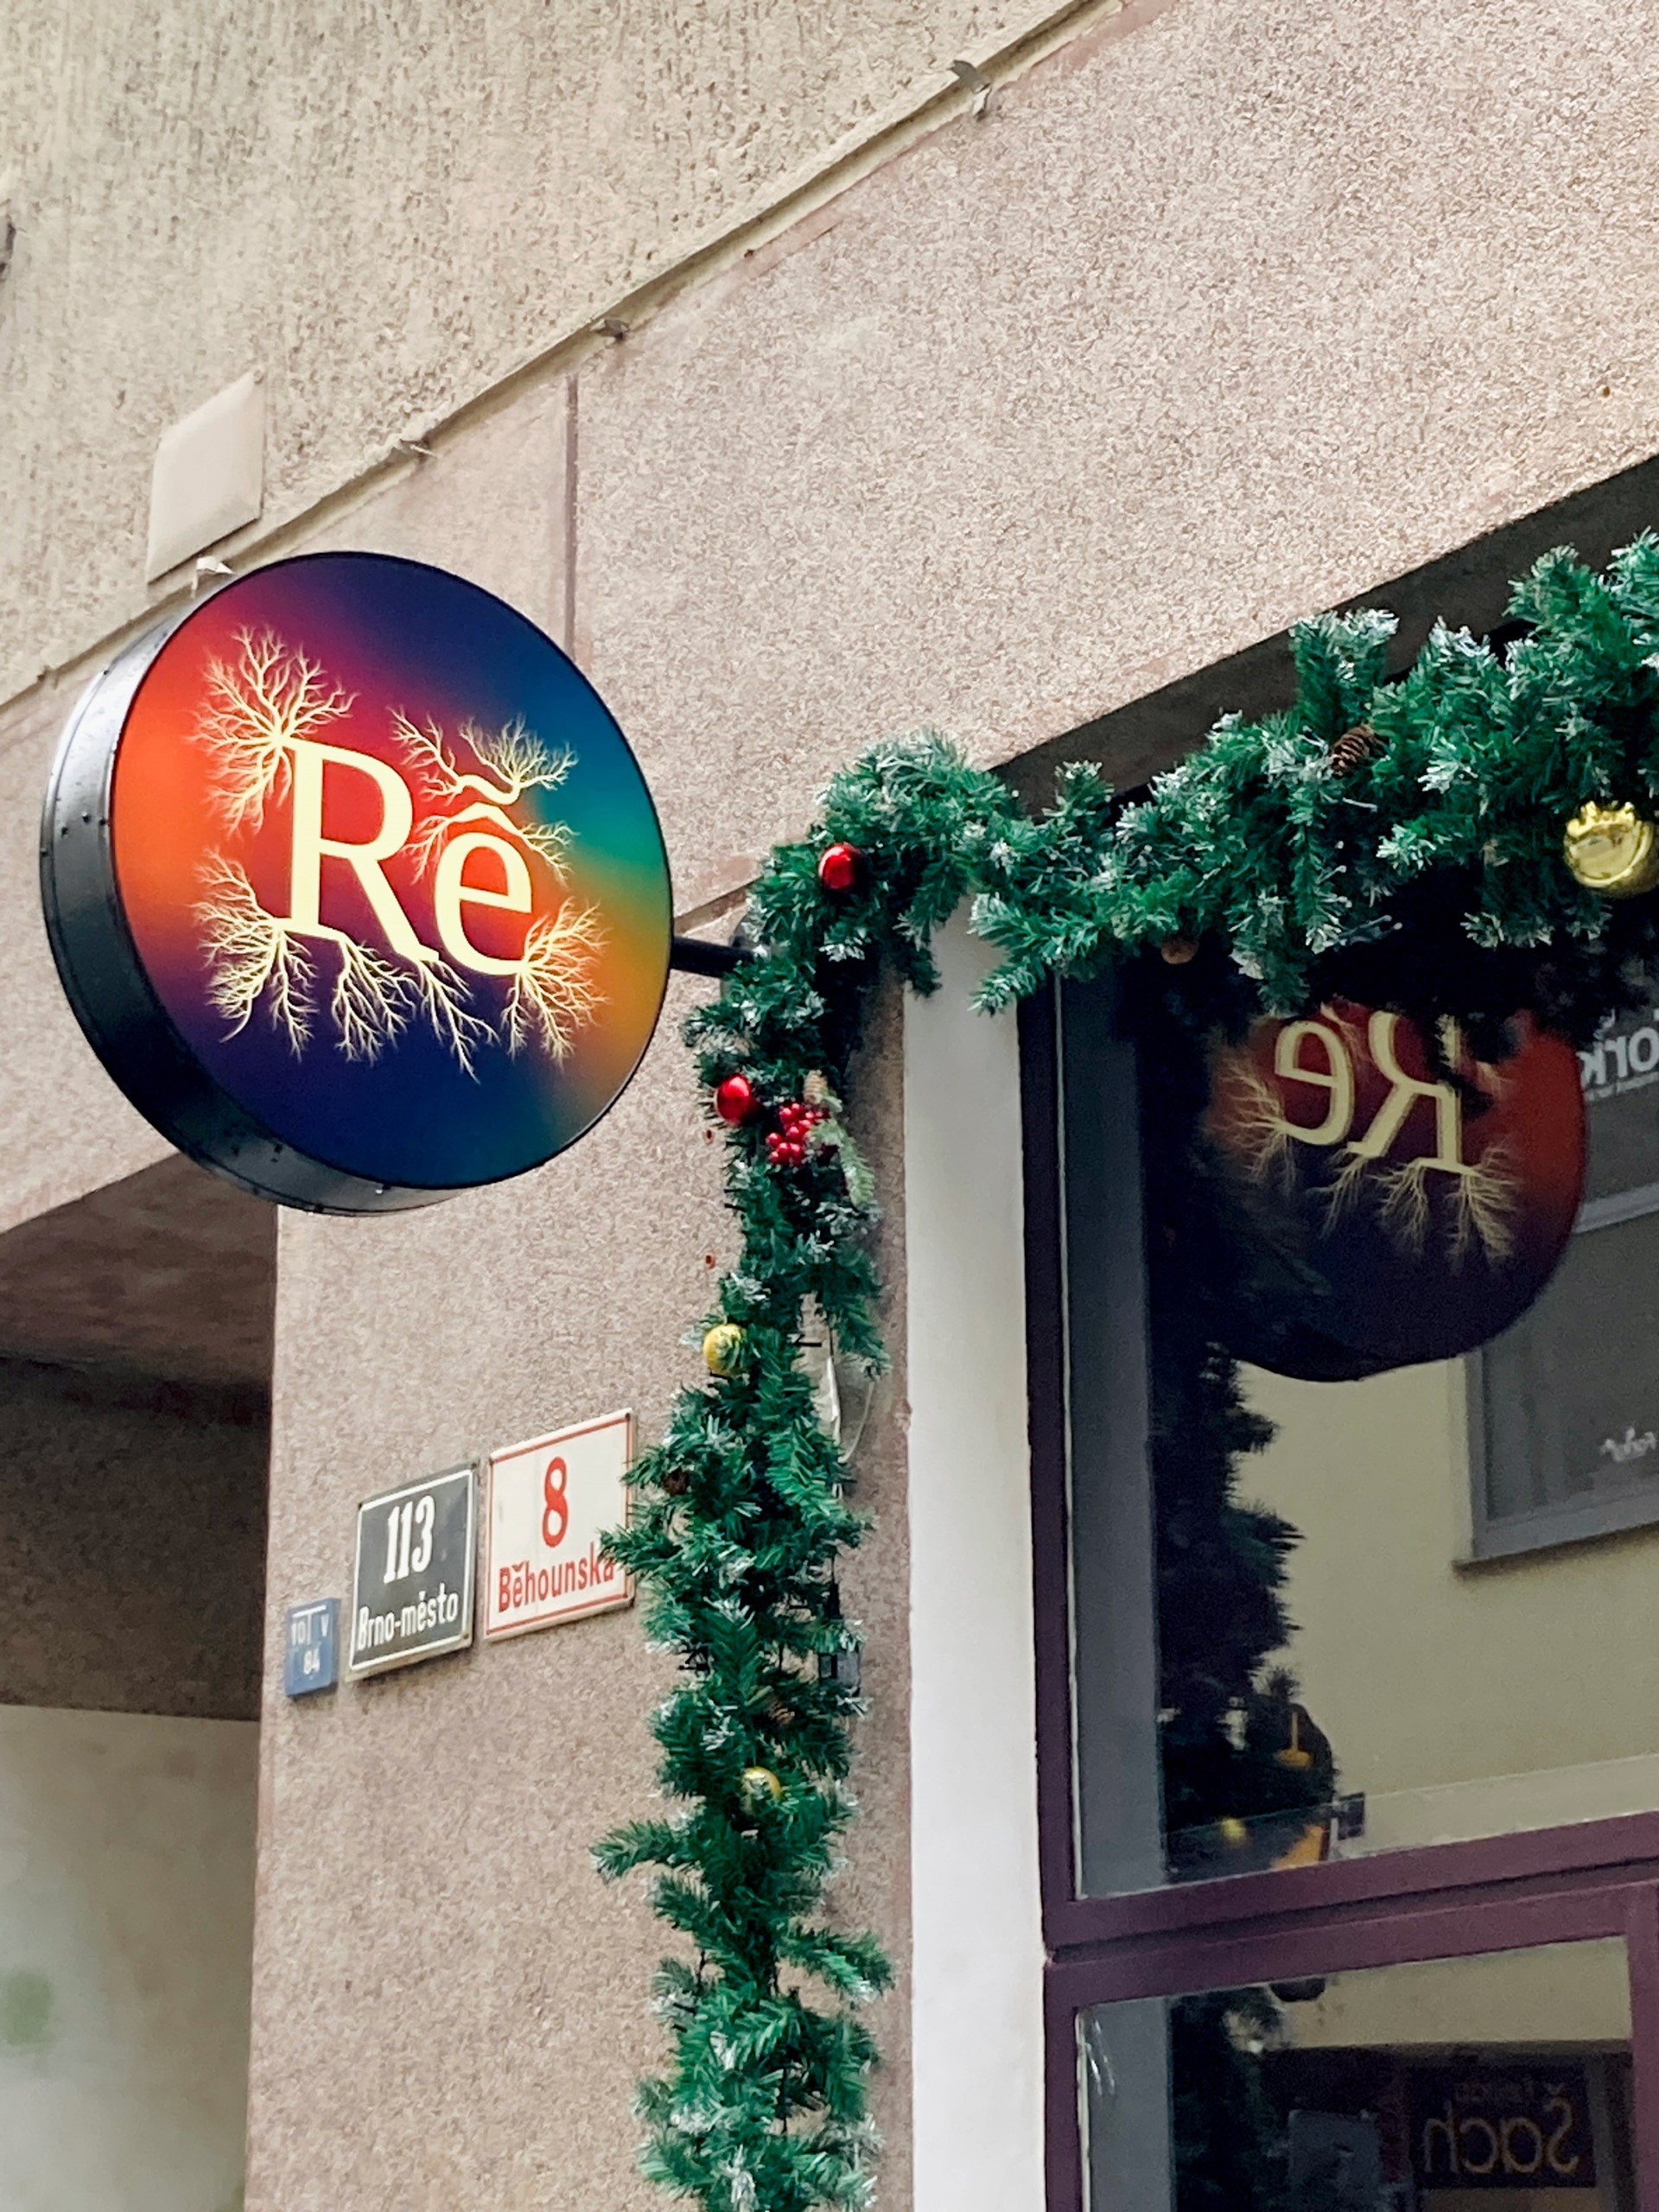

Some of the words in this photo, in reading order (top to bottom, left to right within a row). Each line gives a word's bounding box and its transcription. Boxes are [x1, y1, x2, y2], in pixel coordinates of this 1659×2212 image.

[383, 1495, 435, 1584] 113
[542, 1457, 569, 1548] 8
[356, 1582, 459, 1650] Brno-město
